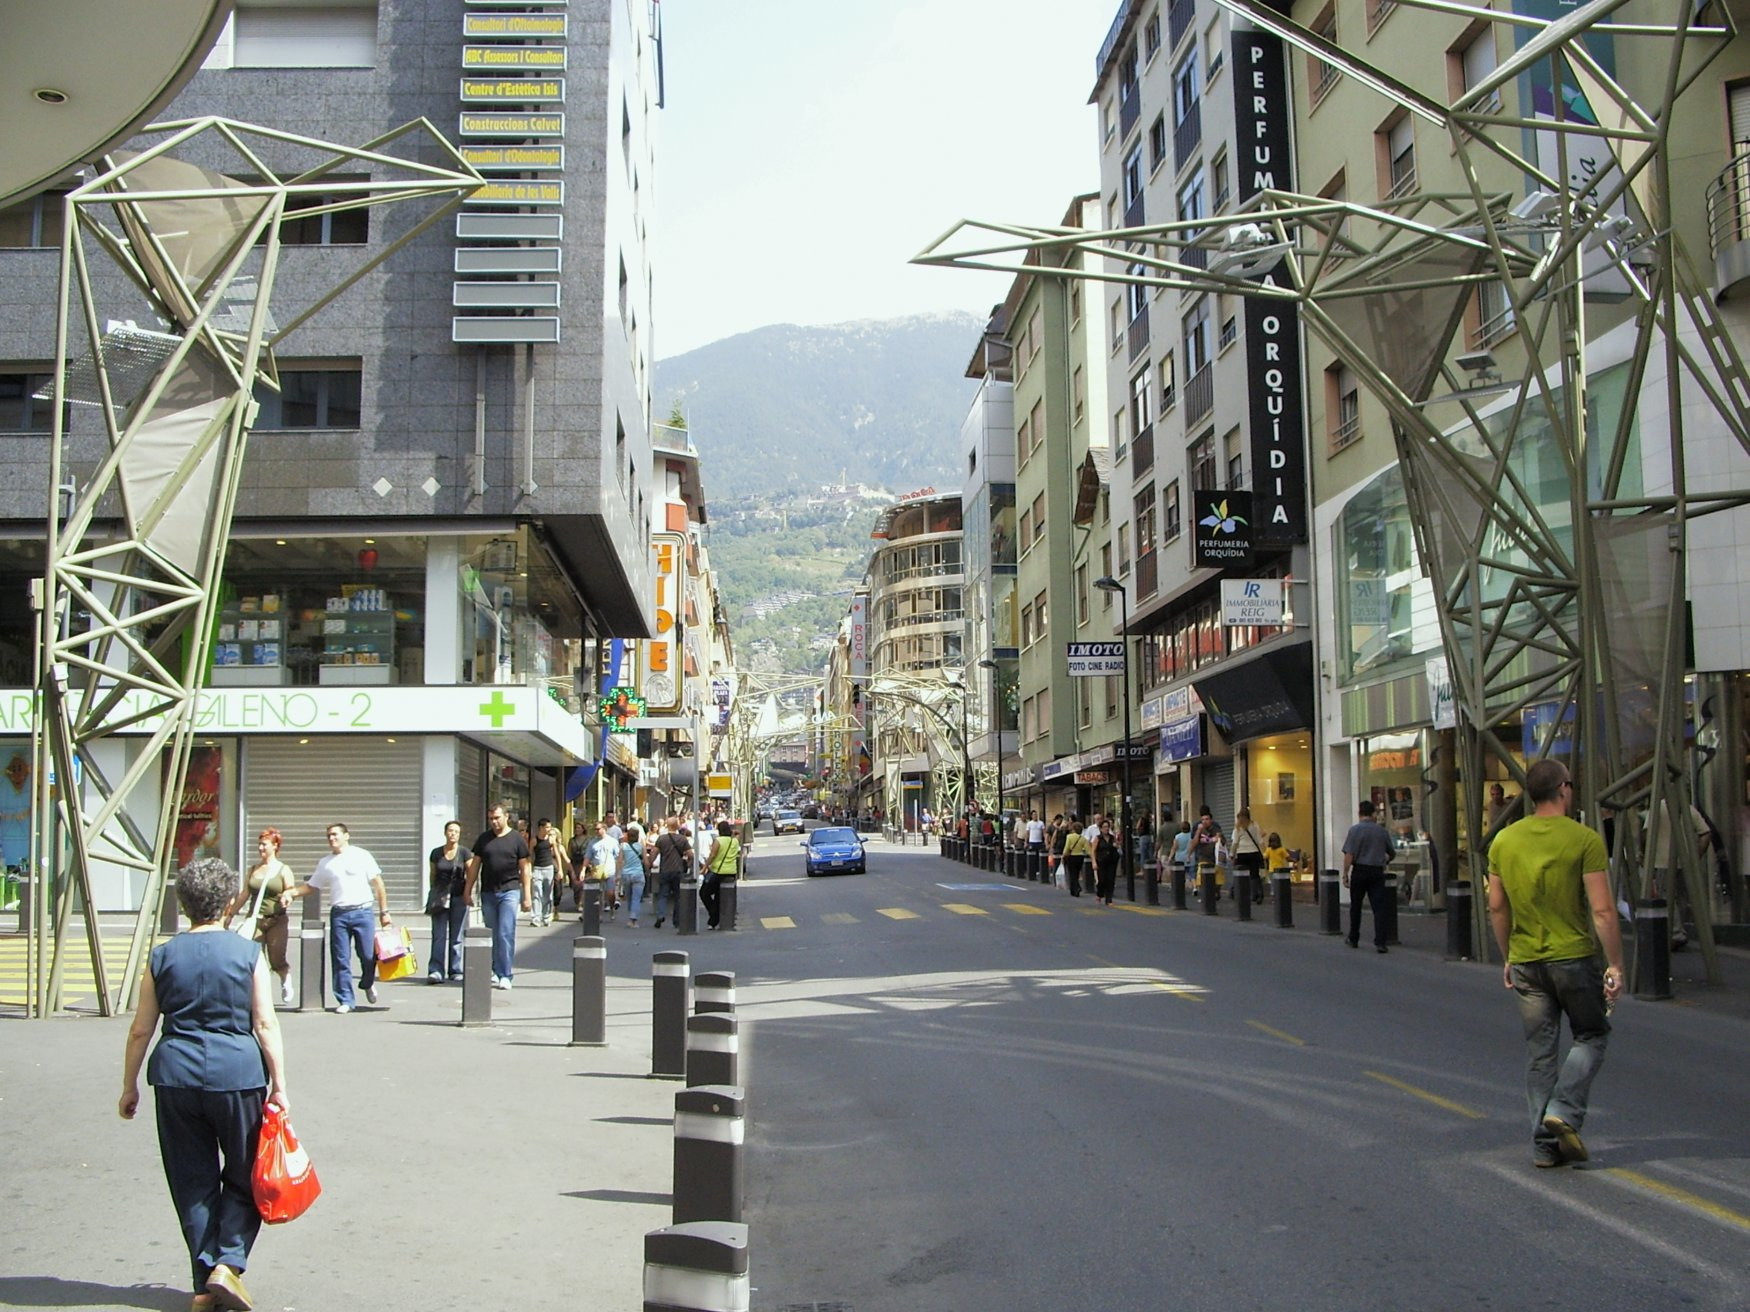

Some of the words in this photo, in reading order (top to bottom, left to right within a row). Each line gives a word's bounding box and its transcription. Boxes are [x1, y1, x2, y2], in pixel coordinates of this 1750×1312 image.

[464, 83, 494, 95] Centre
[463, 117, 529, 130] Construccions
[1251, 46, 1276, 287] PERFUMA
[1262, 315, 1289, 524] ORQUÍDIA
[1200, 540, 1250, 548] PERFUMERIA
[1204, 548, 1246, 558] ORQUÍDIA
[1243, 581, 1261, 598] IR
[1240, 607, 1265, 617] REIG
[854, 624, 863, 660] ROCA
[1068, 643, 1124, 656] IMOTO
[1068, 661, 1086, 671] FOTO
[1087, 661, 1103, 671] CINE
[350, 692, 371, 727] 2
[833, 730, 842, 780] ROLEX
